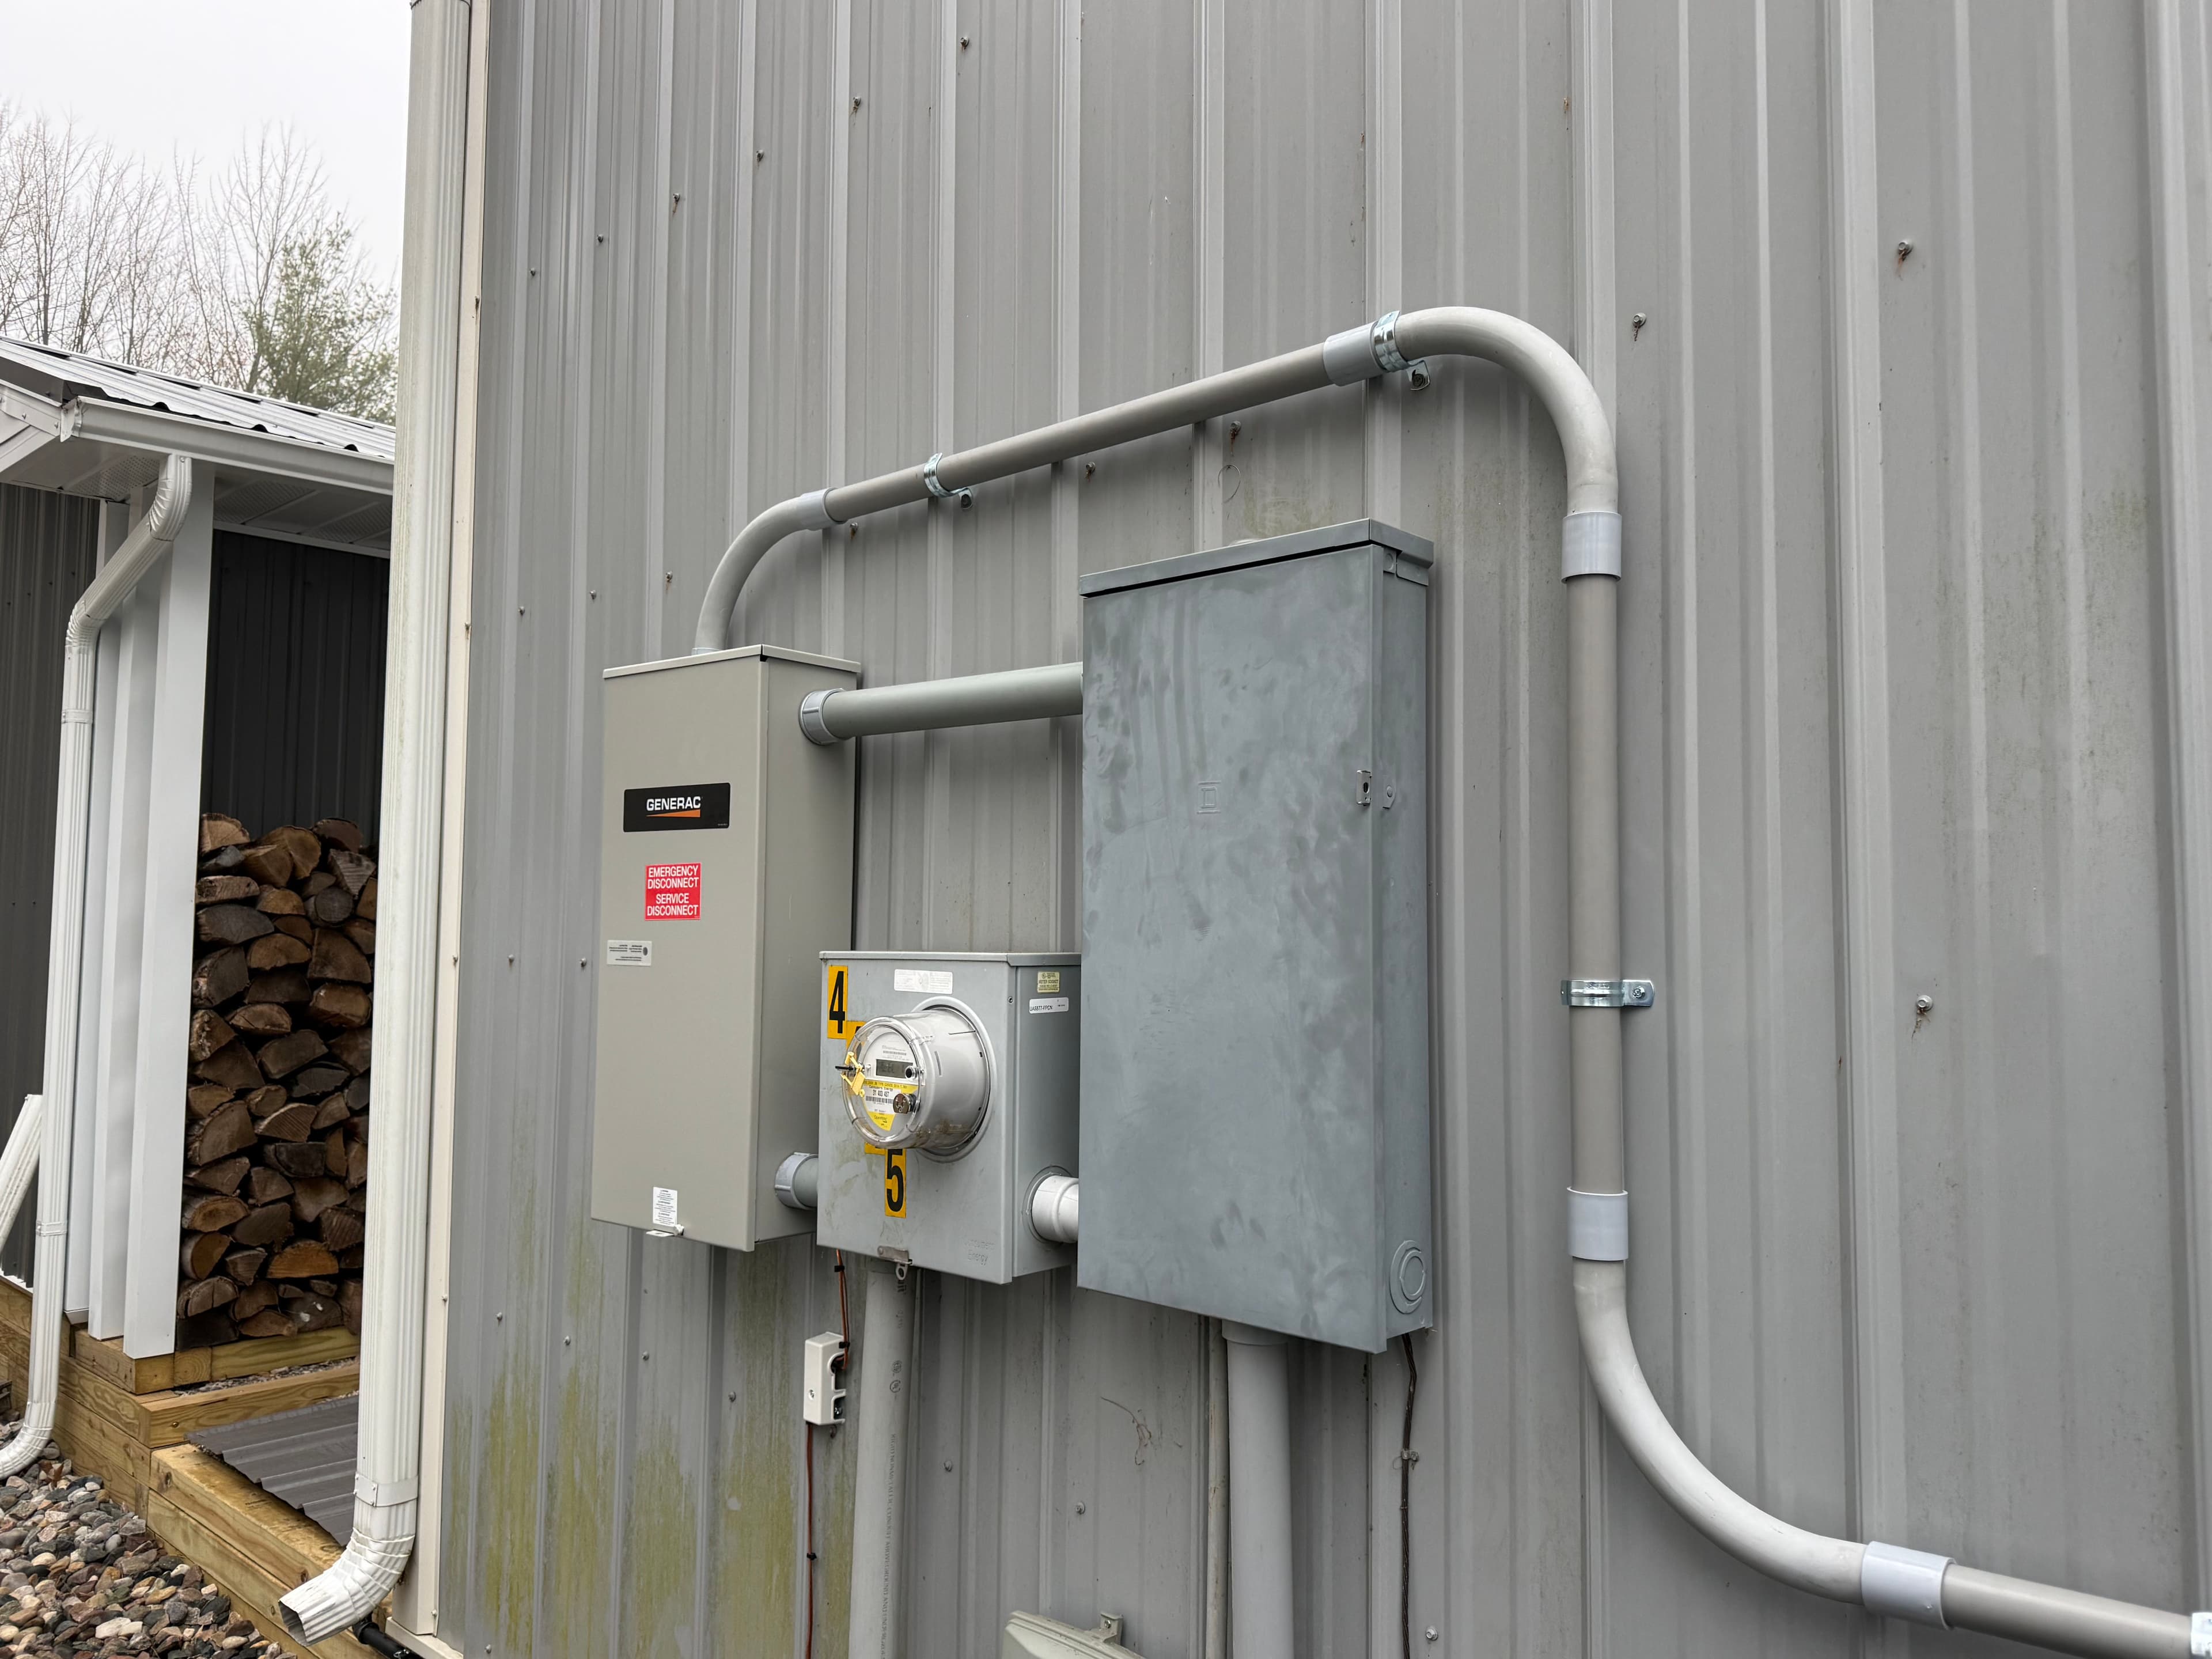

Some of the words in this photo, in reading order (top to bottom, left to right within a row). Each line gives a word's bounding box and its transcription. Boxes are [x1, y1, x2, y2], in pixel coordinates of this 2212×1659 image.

[646, 796, 701, 811] GENERAC
[649, 865, 698, 877] EMERGENCY
[647, 877, 699, 889] DISCONNECT
[656, 893, 690, 904] SERVICE
[647, 904, 698, 916] DISCONNECT
[830, 971, 845, 1033] 4
[887, 1149, 904, 1212] 5
